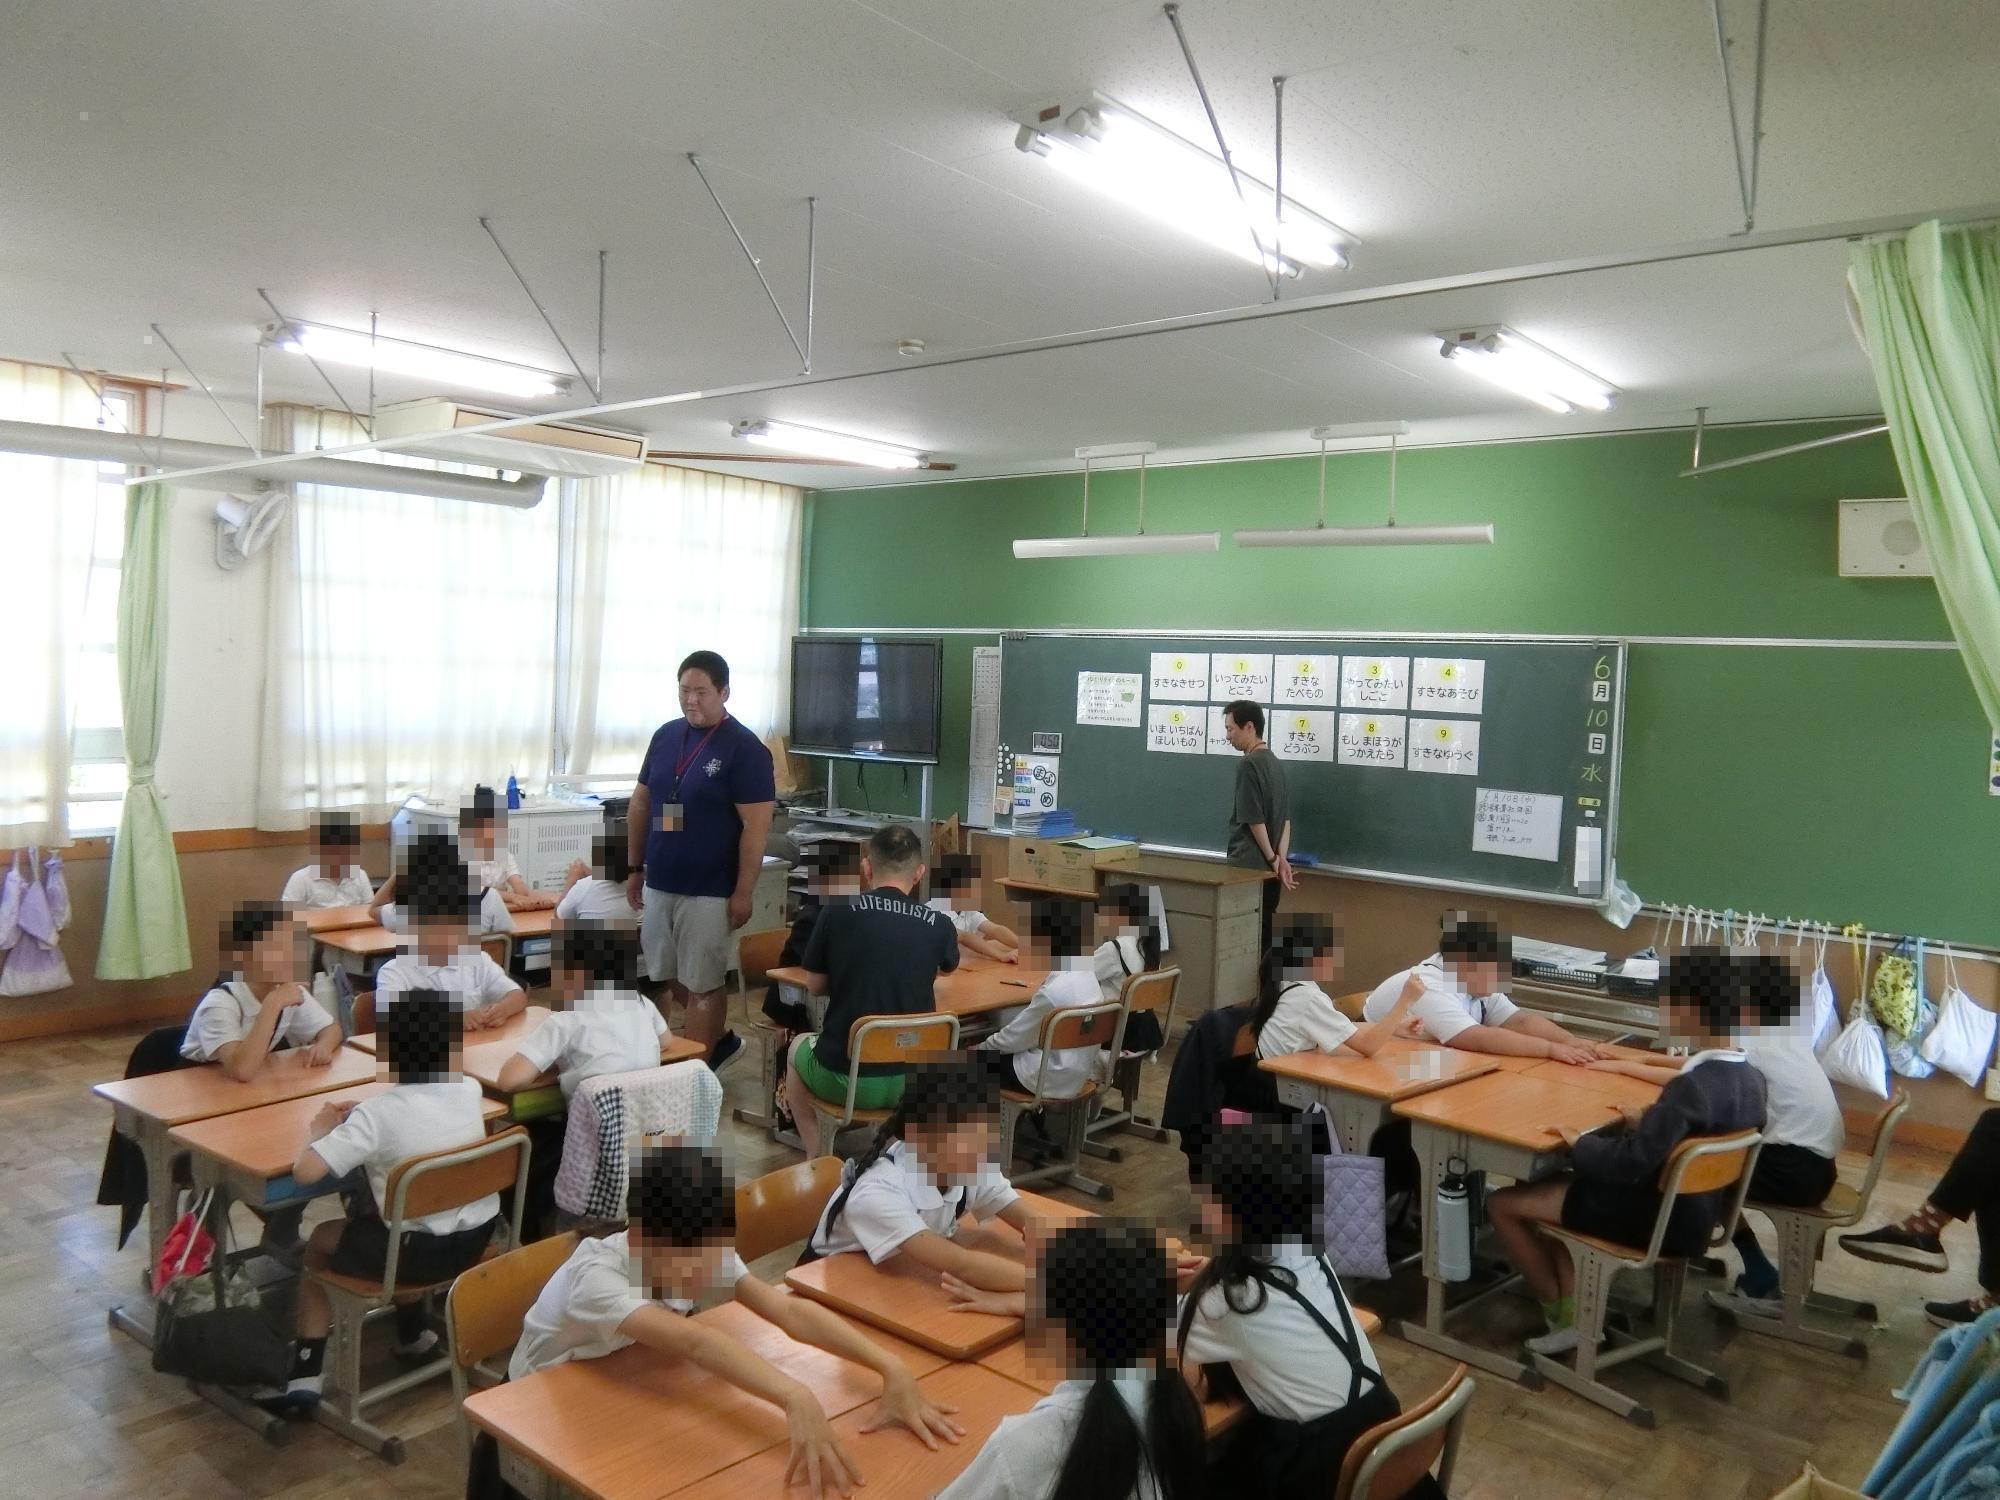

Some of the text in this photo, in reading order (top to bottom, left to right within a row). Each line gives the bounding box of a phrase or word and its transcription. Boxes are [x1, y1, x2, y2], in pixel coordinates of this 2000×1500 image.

[1176, 661, 1183, 669] 0
[1302, 664, 1309, 672] 2
[1371, 666, 1378, 674] 3
[1445, 668, 1451, 676] 4
[1153, 678, 1205, 689] すきなきせつ
[1215, 674, 1268, 684] いってみたい
[1292, 676, 1319, 686] すきな
[1228, 686, 1254, 696] ところ
[1286, 688, 1324, 699] たべもの
[1416, 687, 1480, 700] すきなあそび
[1174, 713, 1180, 721] 5
[1300, 720, 1306, 728] 7
[1368, 724, 1375, 732] 8
[1150, 724, 1204, 736] いま いちばん
[1440, 730, 1447, 738] 9
[1289, 731, 1316, 741] すきな
[1155, 736, 1197, 747] ほしいもの
[1342, 735, 1402, 748] もし まほうが
[1283, 743, 1320, 754] どうぶつ
[1349, 749, 1395, 760] つかえたら
[1412, 747, 1474, 761] すきなゆうぐ
[851, 894, 936, 926] UTEBOLISTA
